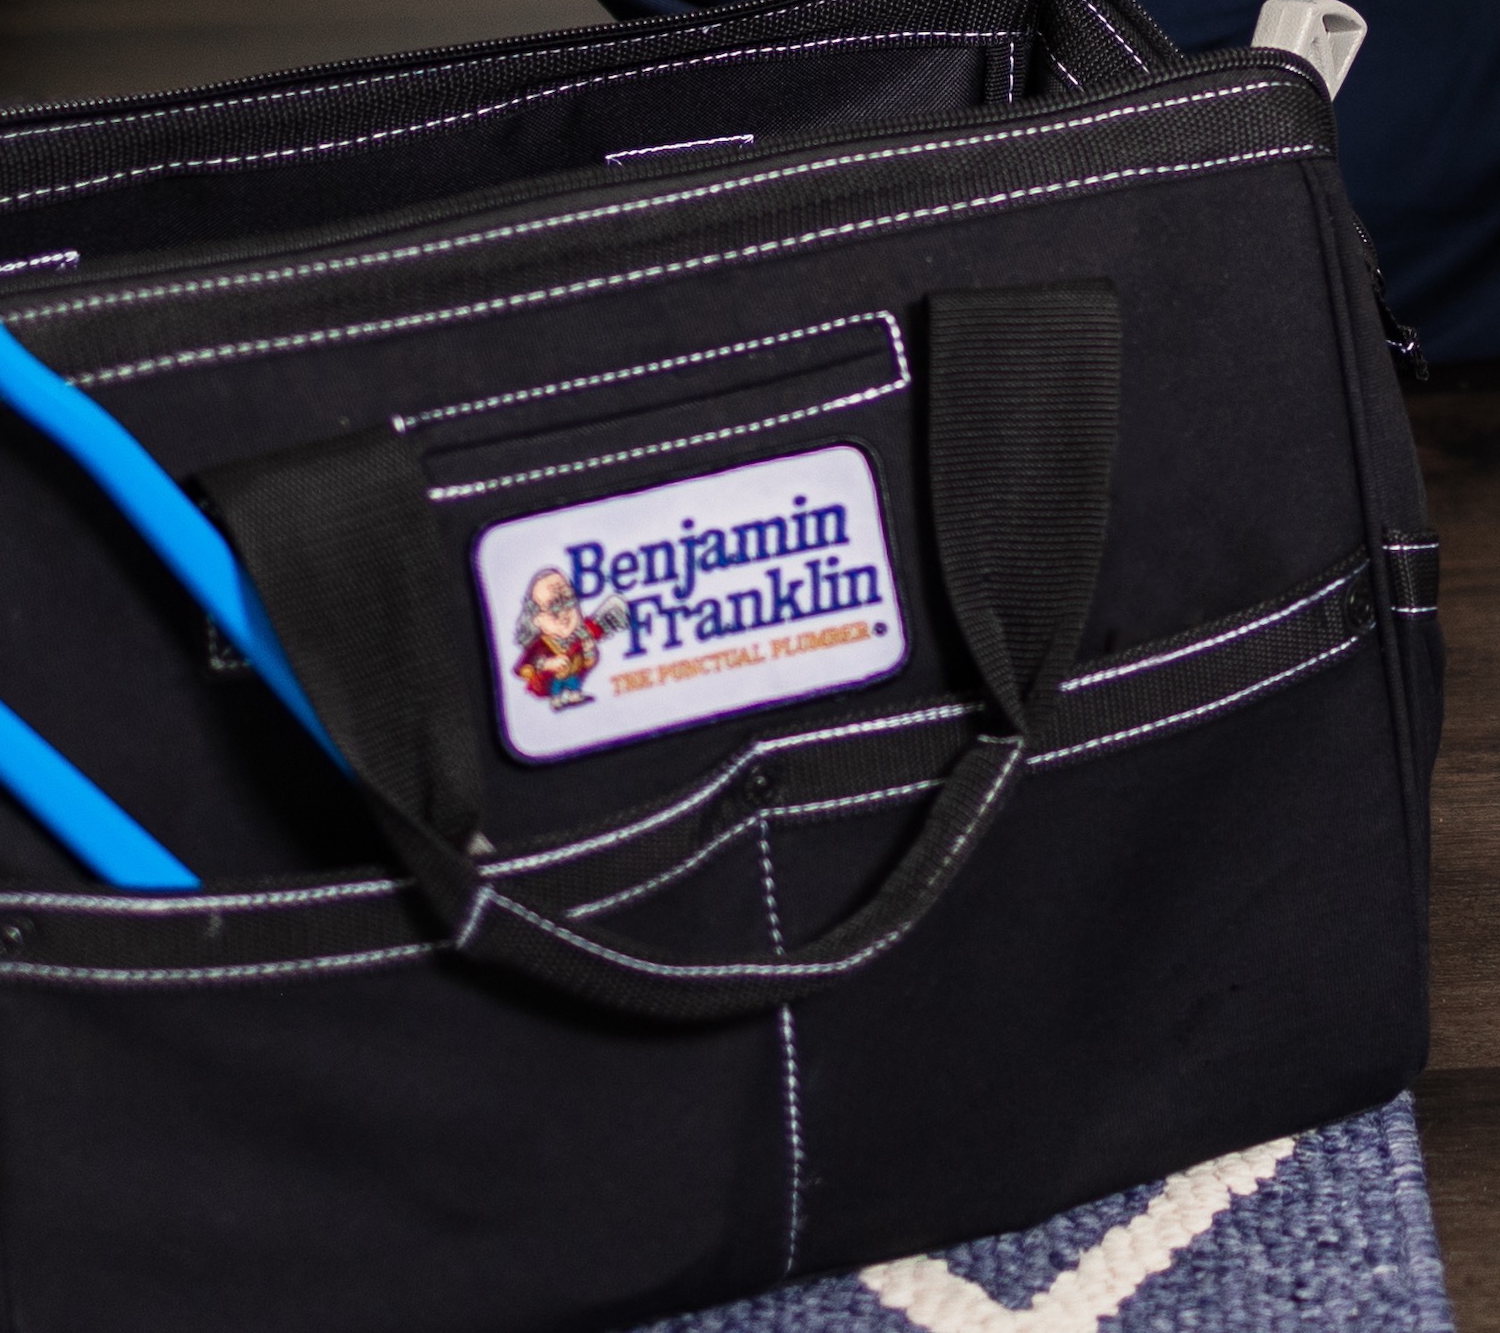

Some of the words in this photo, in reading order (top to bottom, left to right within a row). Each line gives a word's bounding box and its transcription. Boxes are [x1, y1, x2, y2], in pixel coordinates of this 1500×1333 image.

[565, 495, 850, 601] Benjamin
[610, 668, 654, 696] THE
[657, 643, 765, 686] PUNCTUAL
[770, 620, 871, 659] PLUMBER
[622, 556, 883, 660] Franklin
